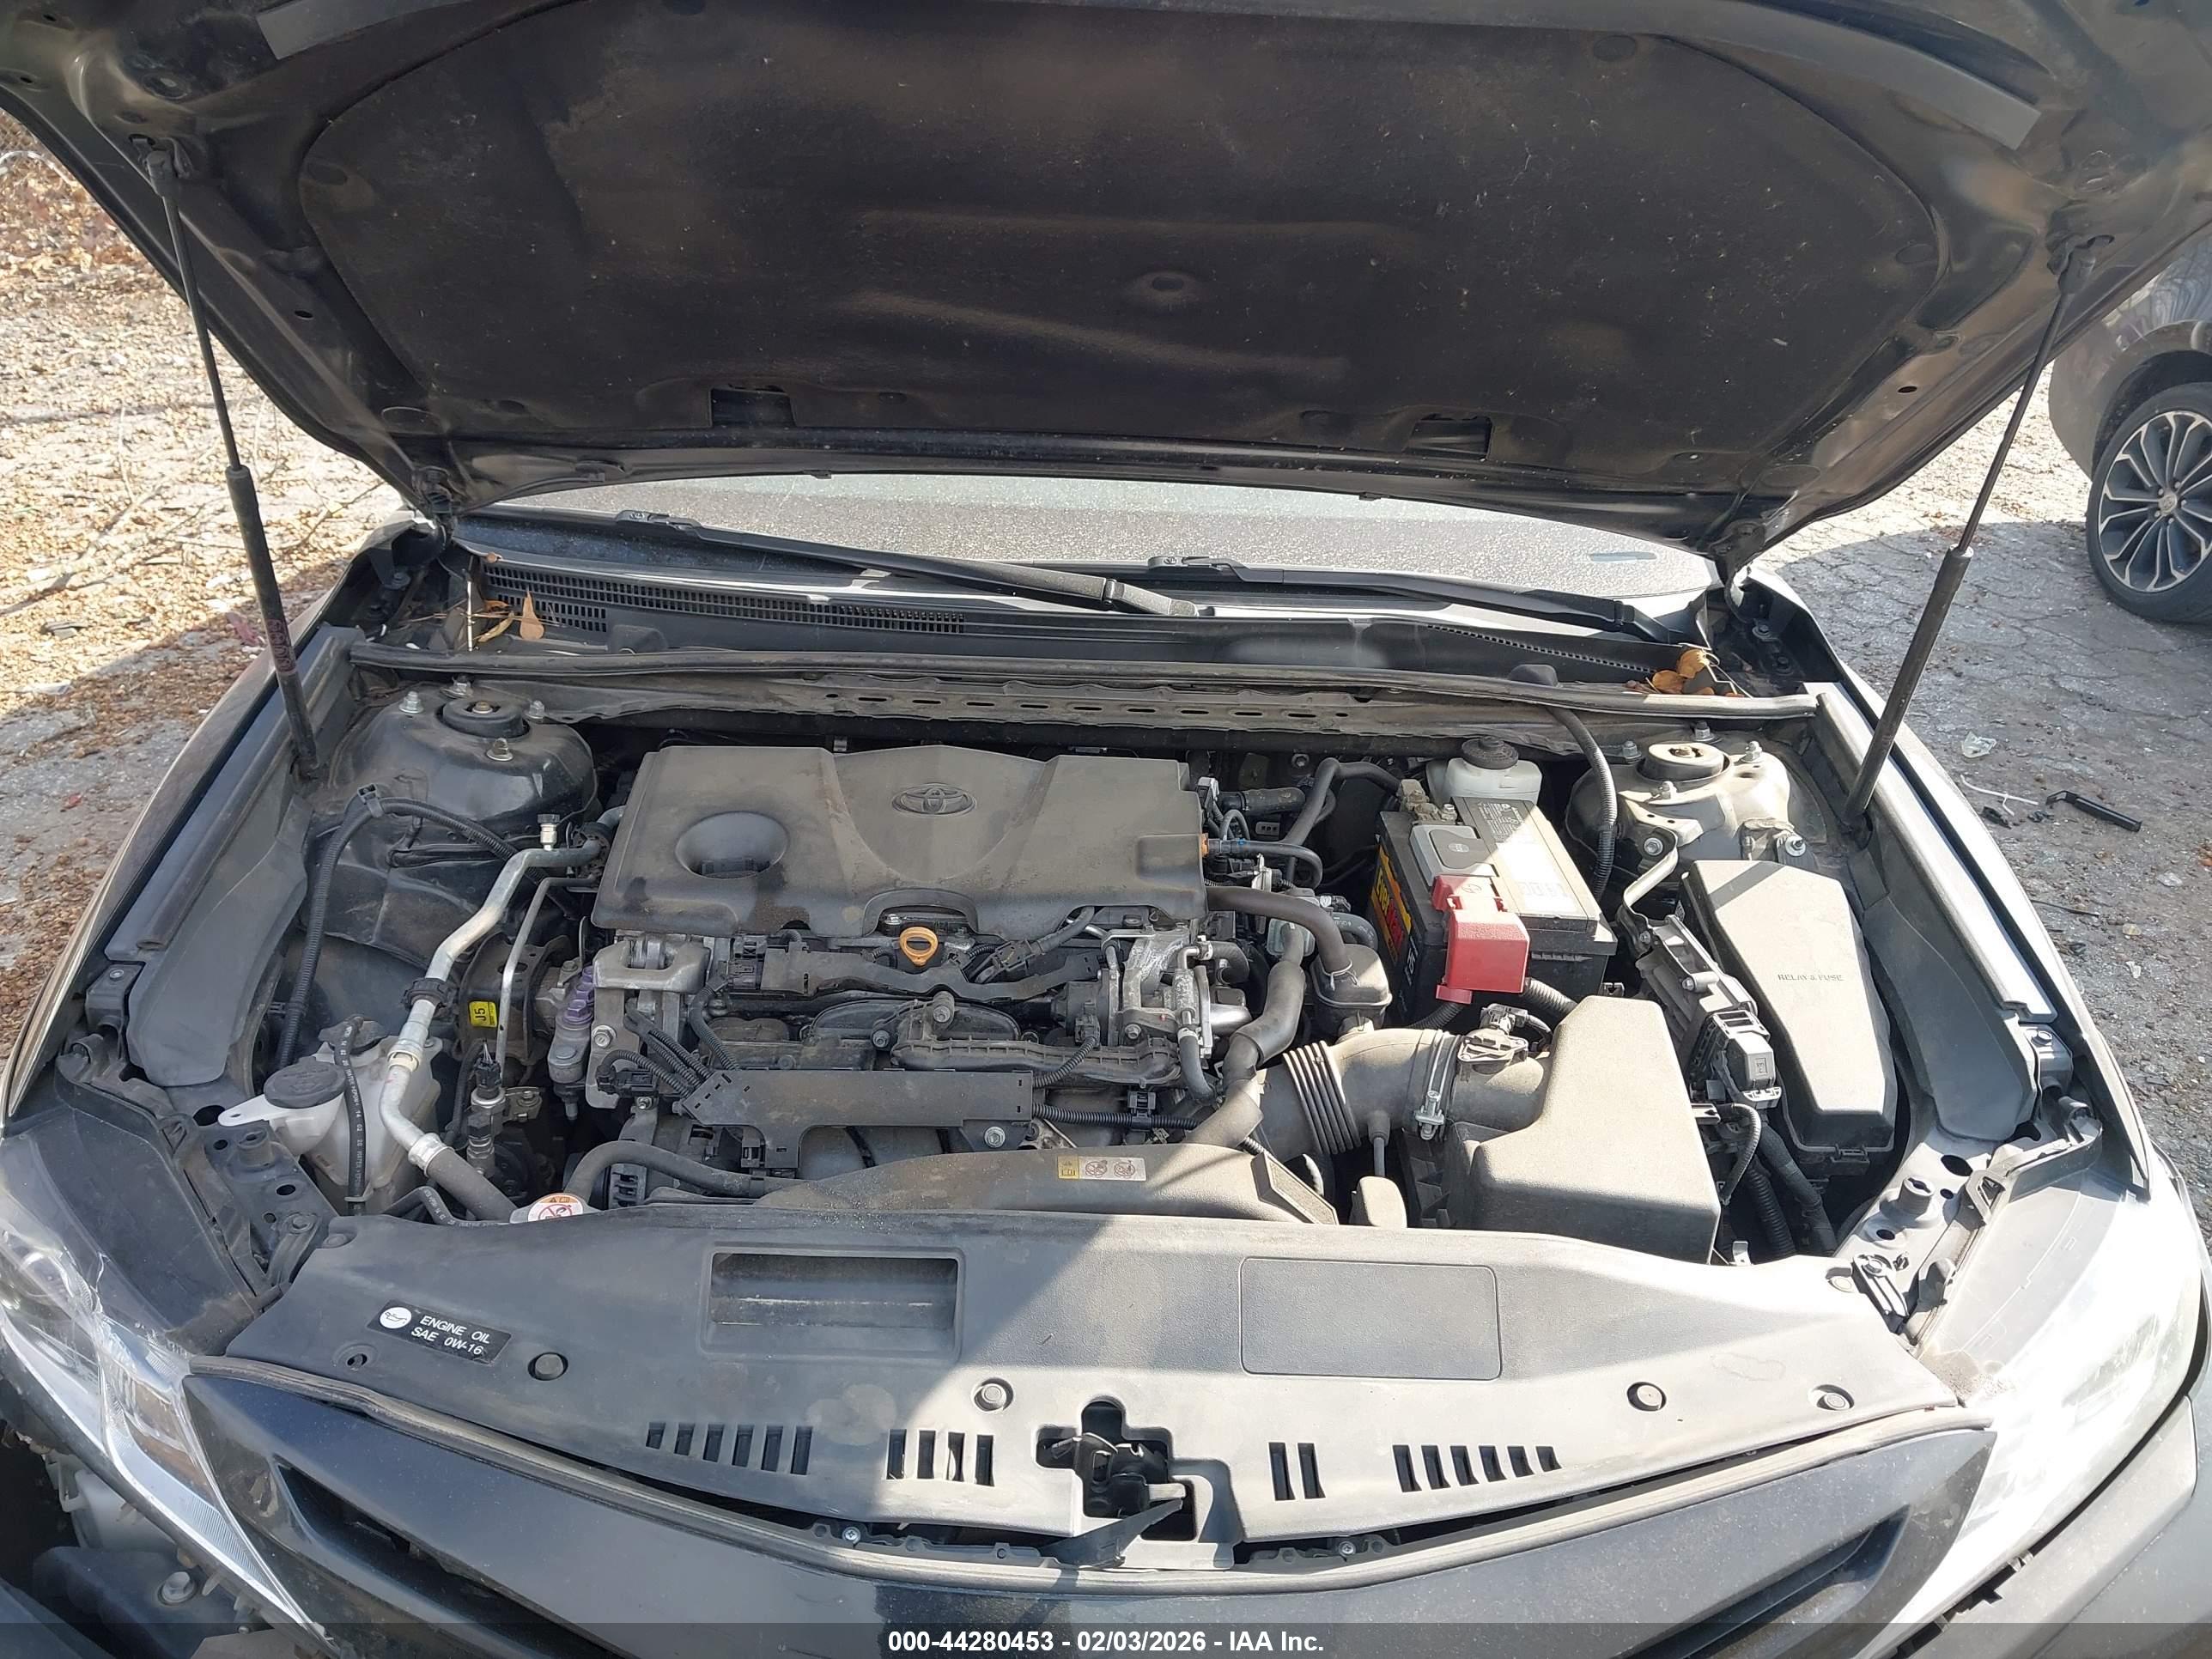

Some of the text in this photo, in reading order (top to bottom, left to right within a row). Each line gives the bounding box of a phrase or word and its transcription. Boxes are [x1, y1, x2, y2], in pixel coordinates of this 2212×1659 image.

[474, 1008, 486, 1021] J5
[411, 1327, 483, 1355] SAE 0W-16
[420, 1316, 491, 1345] ENGINE OIL
